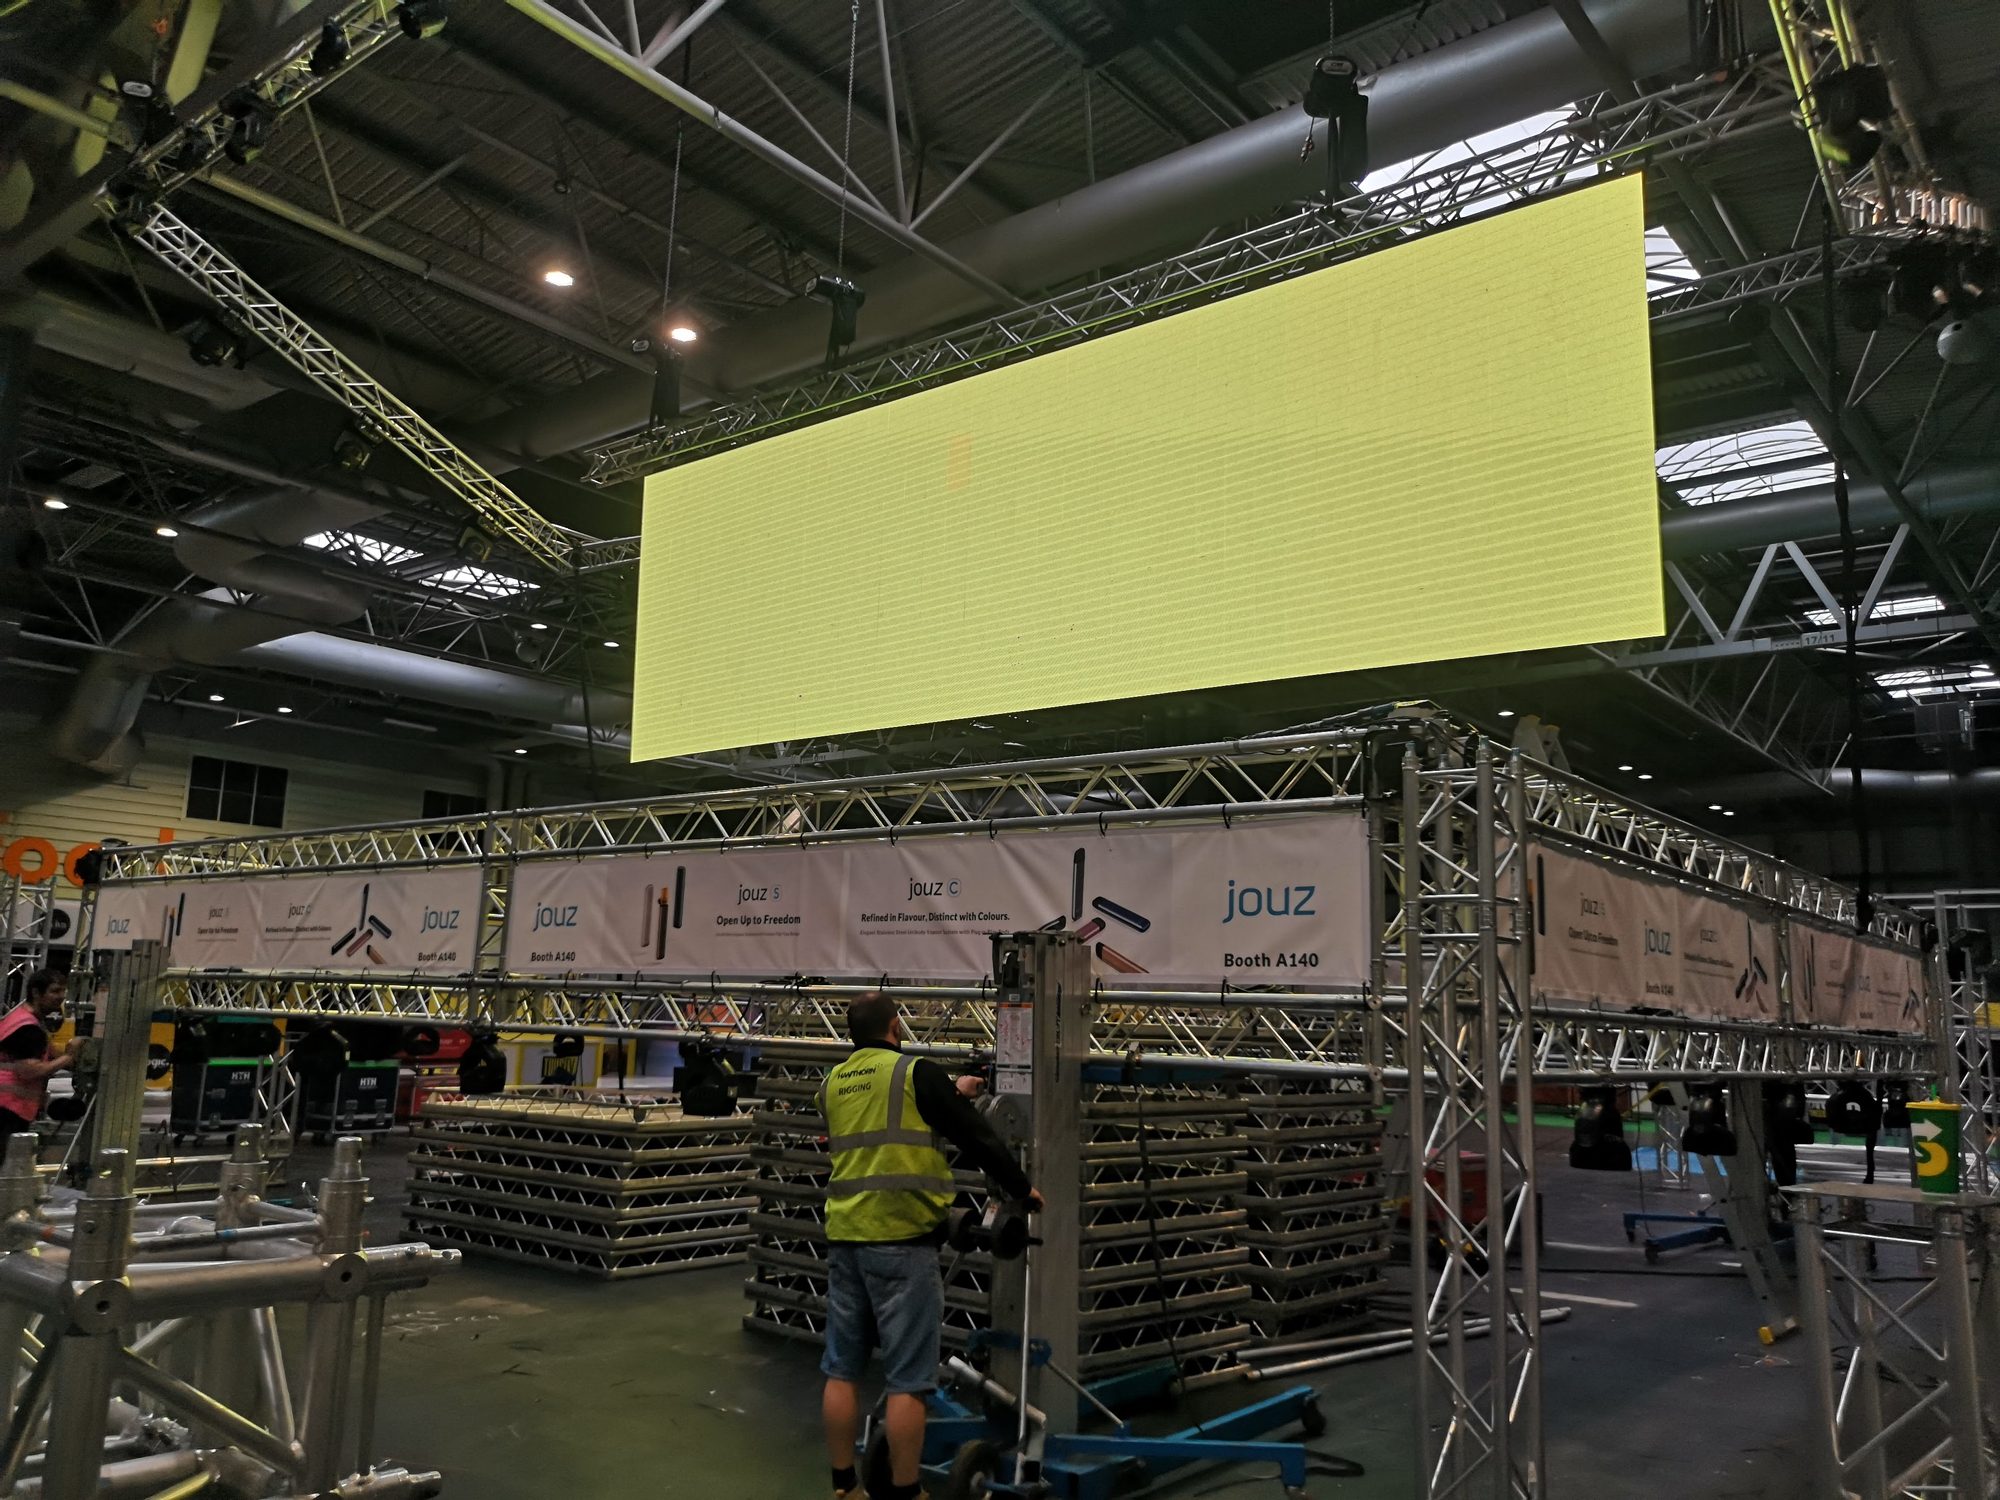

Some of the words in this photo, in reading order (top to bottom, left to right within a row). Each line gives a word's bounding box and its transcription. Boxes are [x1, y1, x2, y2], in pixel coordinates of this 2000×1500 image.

[737, 884, 768, 905] jouz
[908, 878, 943, 900] jouz
[1222, 880, 1316, 924] jouz
[105, 915, 131, 937] jouz
[421, 906, 460, 933] jouz
[533, 902, 578, 932] jouz
[716, 915, 739, 926] Open
[740, 915, 752, 926] Up
[753, 916, 762, 924] to
[764, 914, 801, 924] Freedom
[861, 914, 889, 922] Refined
[890, 914, 897, 922] in
[898, 913, 928, 923] Flavour,
[929, 912, 958, 922] Distinct
[960, 912, 977, 921] with
[978, 912, 1010, 921] Colours.
[1644, 920, 1672, 956] jouz
[418, 952, 437, 962] Booth
[438, 952, 457, 962] A140
[530, 952, 554, 962] Booth
[555, 951, 576, 962] A140
[1224, 953, 1271, 967] Booth
[1276, 953, 1319, 967] A140
[838, 1081, 872, 1096] RIGGING
